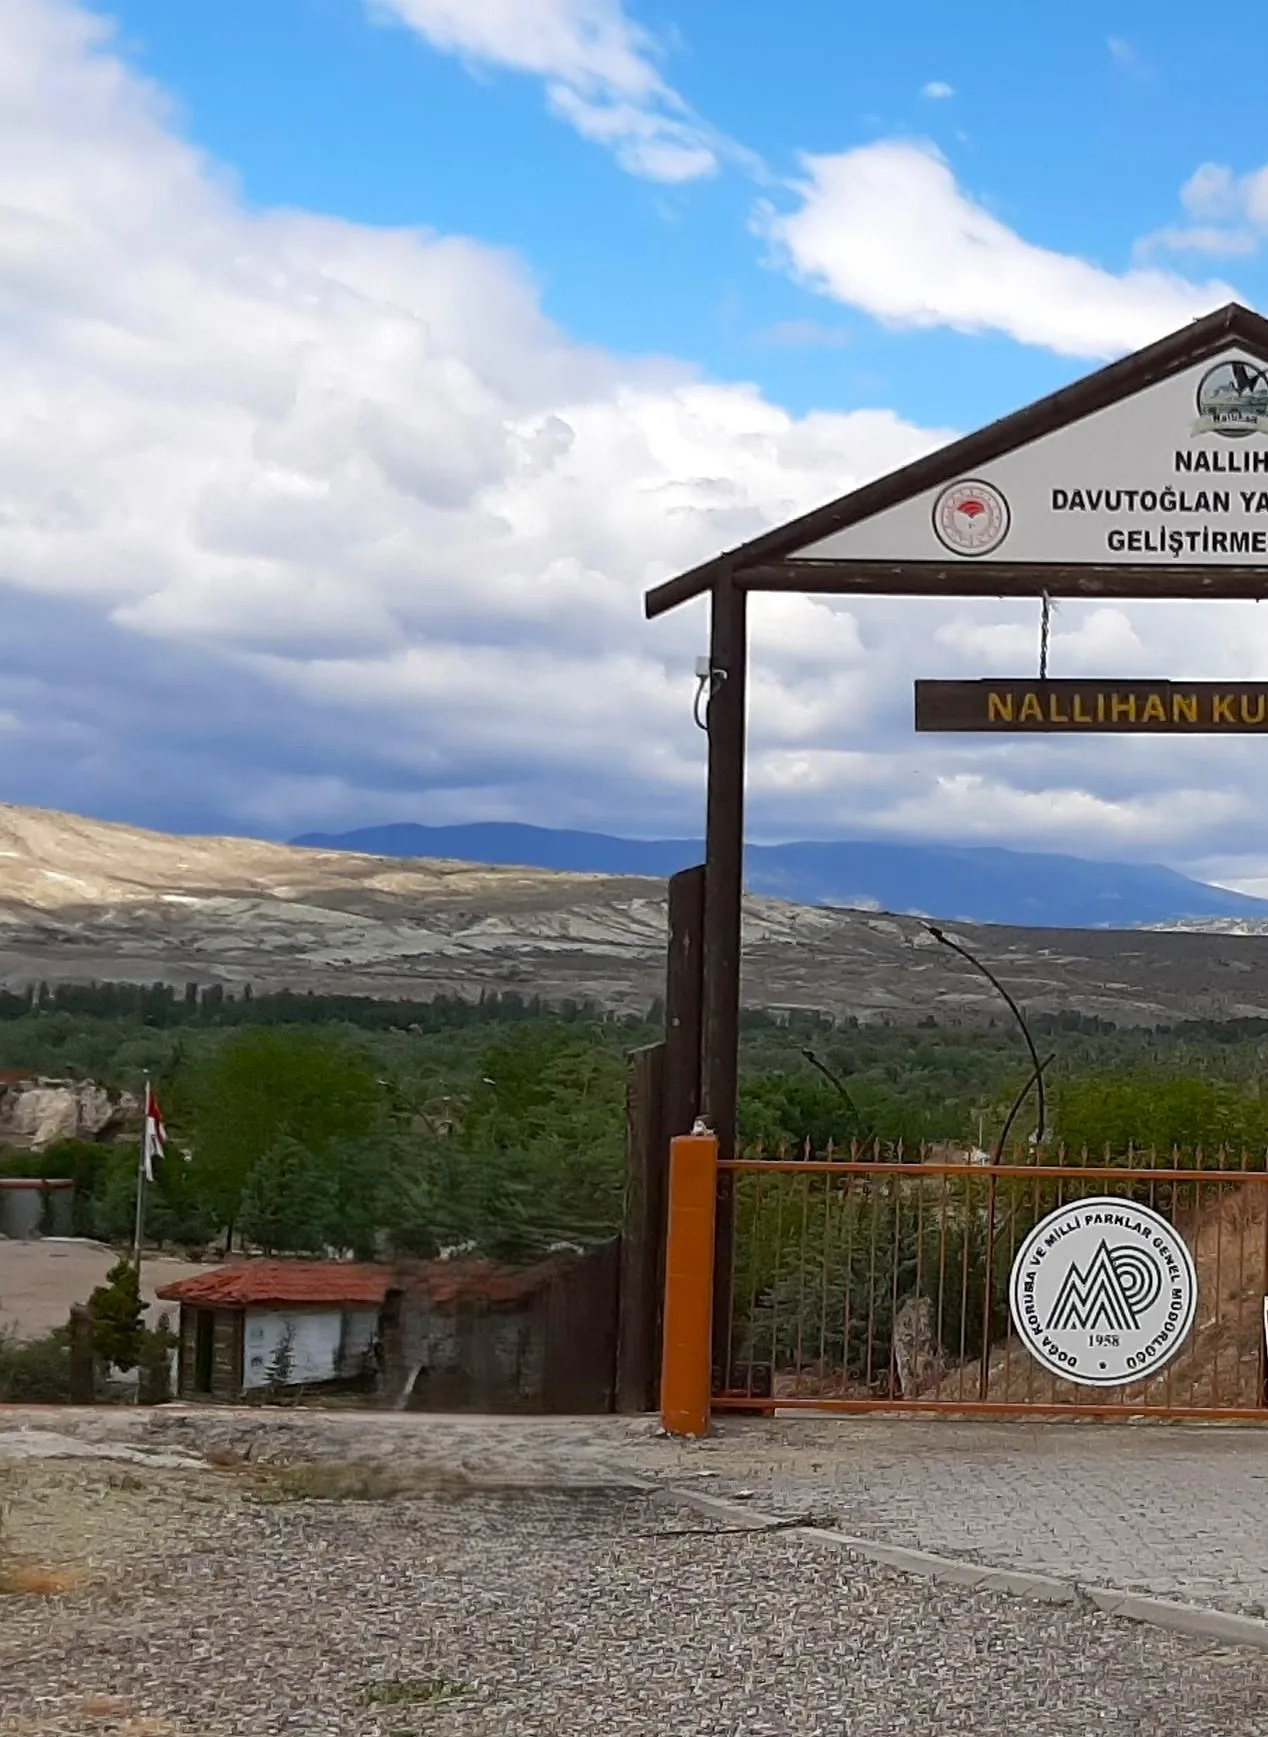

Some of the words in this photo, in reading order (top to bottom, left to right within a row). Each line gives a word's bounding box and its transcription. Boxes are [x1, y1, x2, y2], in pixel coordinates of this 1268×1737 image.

[1051, 485, 1230, 513] DAVUTOĞLAN
[1107, 525, 1267, 558] GELİŞTİRME
[986, 692, 1199, 723] NALLIHAN
[1029, 1246, 1047, 1266] VE
[1084, 1213, 1153, 1239] PARKLAR
[1152, 1237, 1181, 1283] GENEL
[1088, 1333, 1120, 1348] 1958
